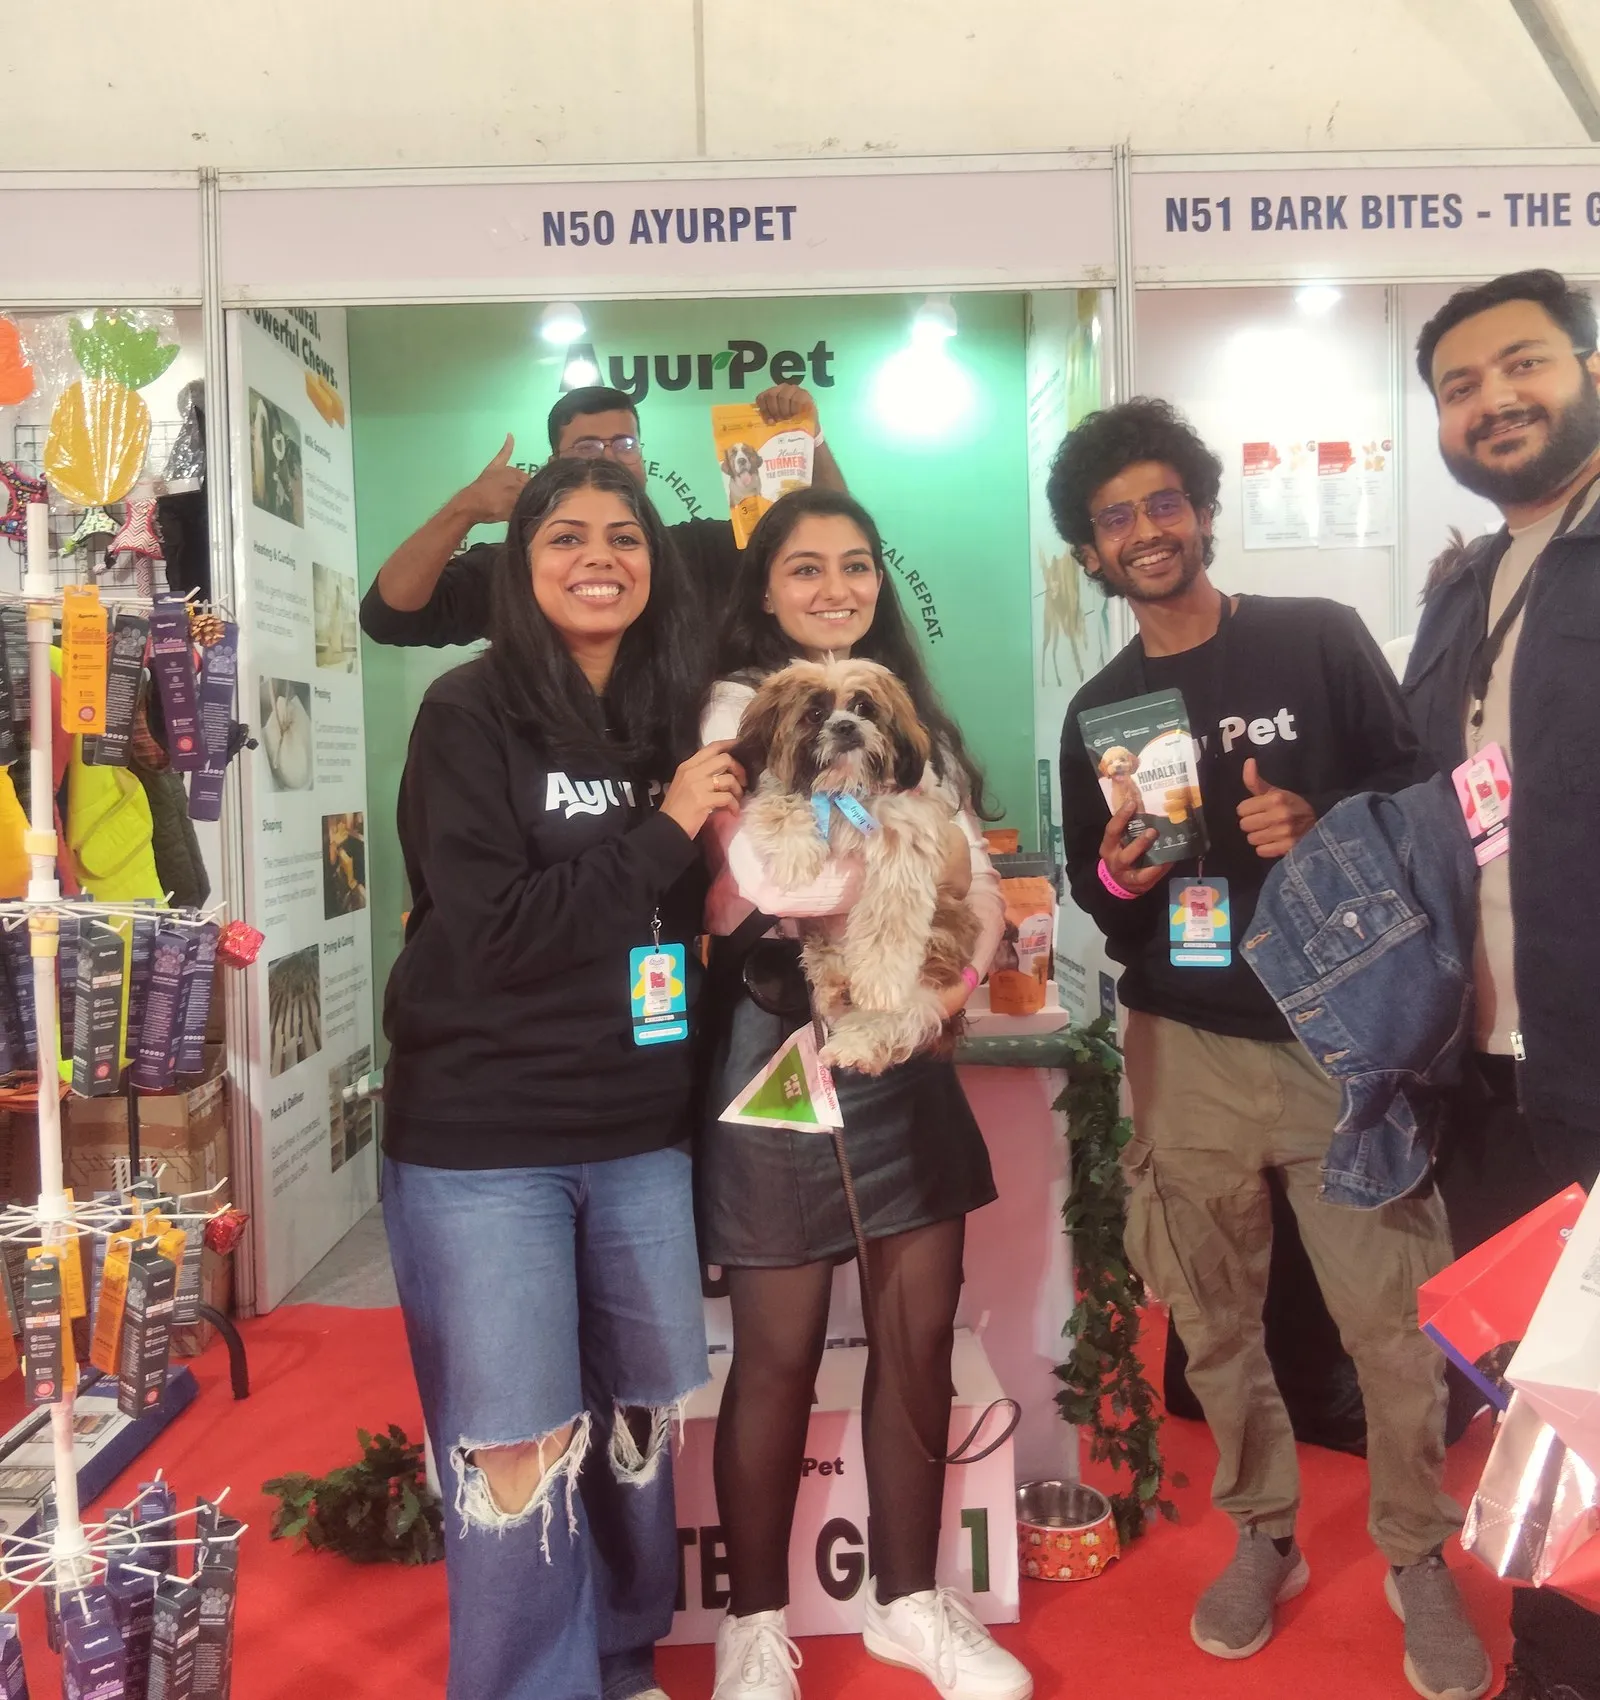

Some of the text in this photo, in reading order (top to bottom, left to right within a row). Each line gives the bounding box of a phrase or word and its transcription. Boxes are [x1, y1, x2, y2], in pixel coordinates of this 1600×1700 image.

[542, 205, 797, 247] N50 AYURPET
[1165, 197, 1232, 233] N51
[1250, 195, 1349, 231] BARK
[1361, 193, 1464, 230] BITES
[1503, 192, 1572, 228] THE
[246, 308, 338, 389] owerful Chews.
[558, 340, 835, 406] AyurPet
[905, 569, 944, 645] REPEAT.
[960, 1507, 990, 1593] 1
